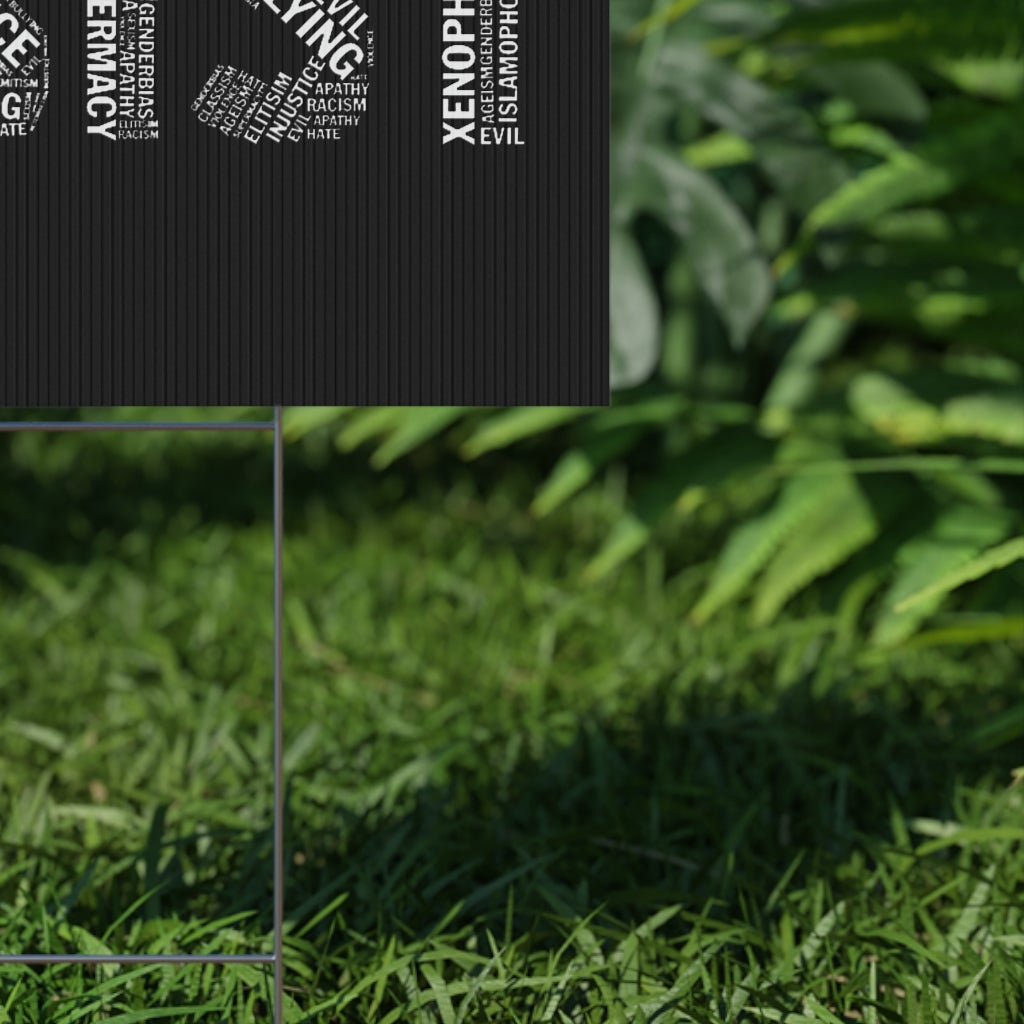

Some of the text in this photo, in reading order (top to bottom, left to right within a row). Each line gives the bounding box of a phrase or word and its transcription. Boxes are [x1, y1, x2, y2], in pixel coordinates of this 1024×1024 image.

[21, 55, 43, 77] EVIL
[138, 2, 156, 120] GENDERBIAS
[119, 50, 136, 119] APATHY
[197, 65, 238, 123] CLASSISM
[237, 70, 269, 96] HATE
[315, 82, 370, 95] APATHY
[480, 66, 495, 124] AGEISM
[219, 85, 255, 137] AGEISM
[243, 71, 293, 145] ELITISIM
[265, 55, 326, 144] INJUSTICE
[307, 97, 367, 112] RACISM
[287, 114, 312, 143] EVIL
[313, 114, 361, 126] APATHY
[118, 130, 159, 139] RACISM
[307, 128, 342, 140] HATE
[480, 127, 525, 145] EVIL
